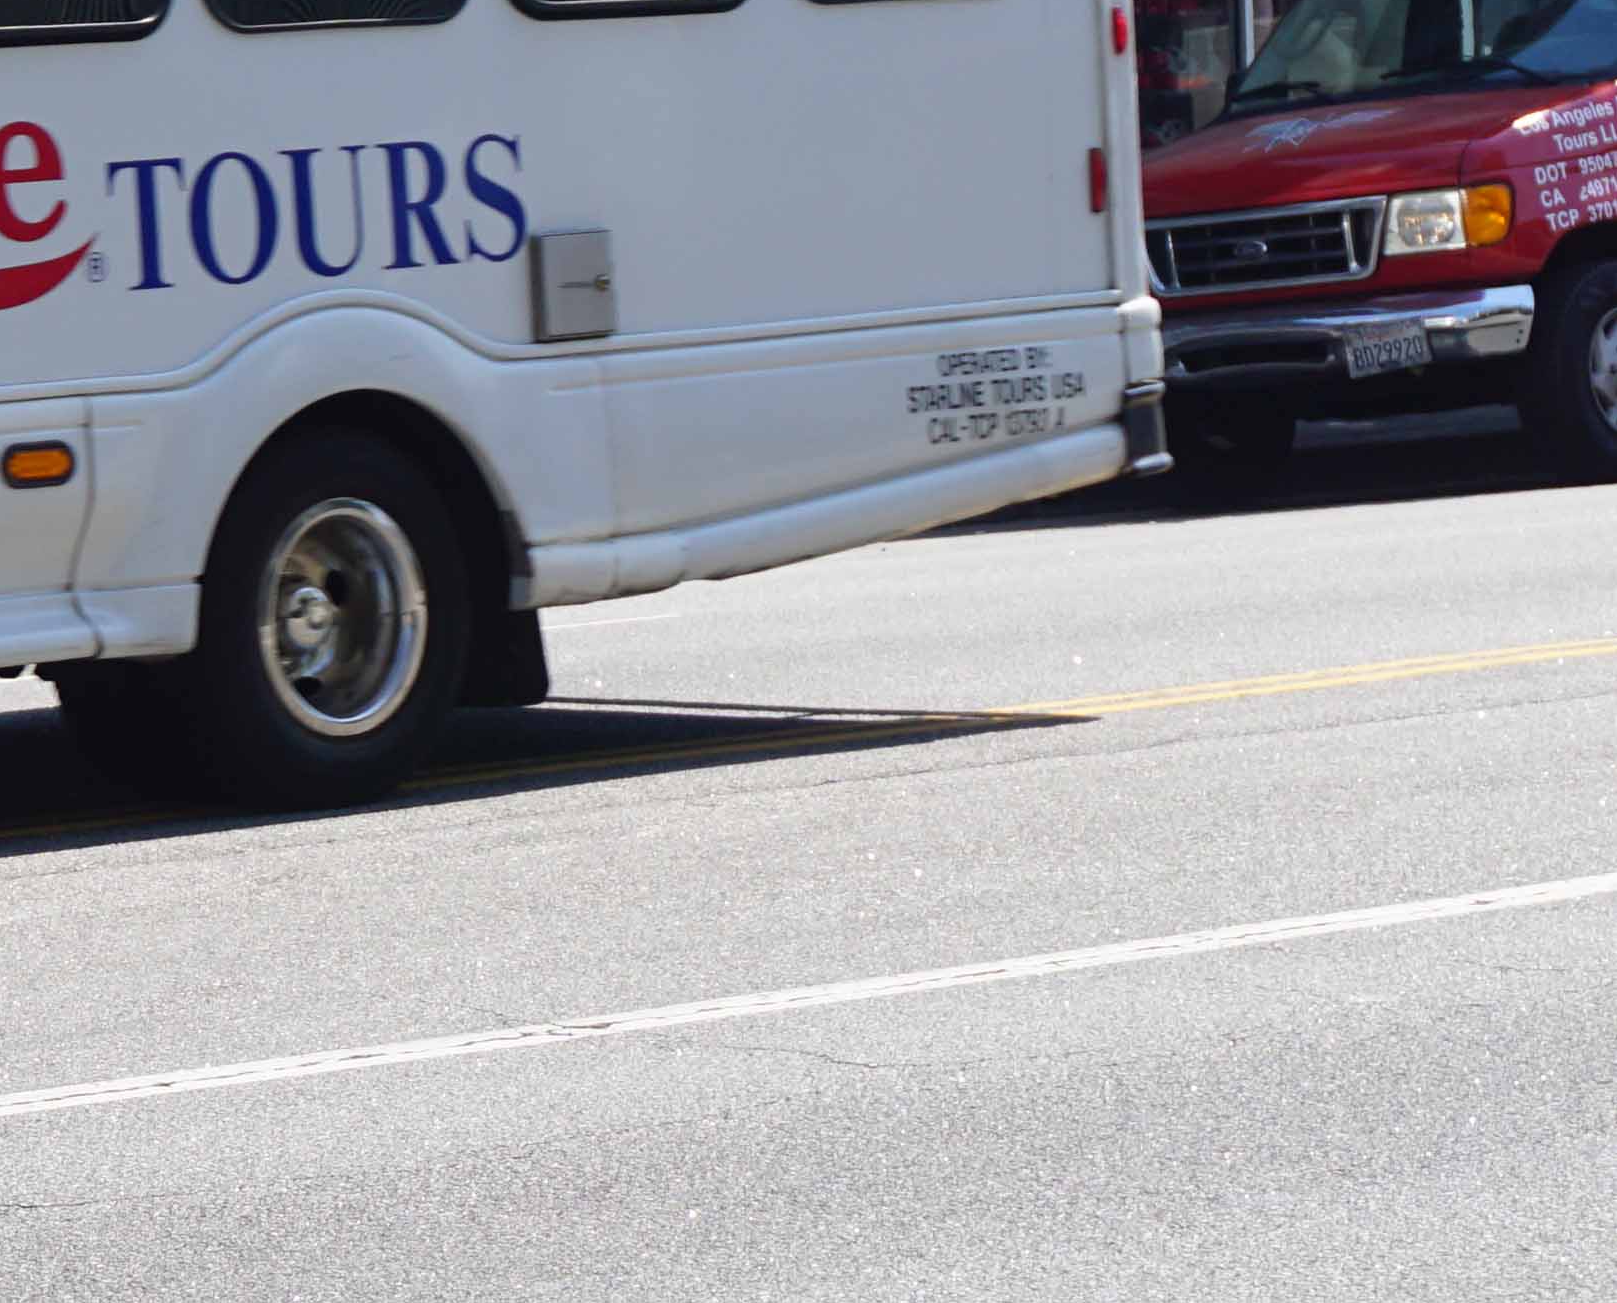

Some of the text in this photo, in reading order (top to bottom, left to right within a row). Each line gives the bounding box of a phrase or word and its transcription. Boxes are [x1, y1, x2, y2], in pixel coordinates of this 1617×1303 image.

[1551, 100, 1614, 128] Angeles
[1552, 130, 1598, 155] Tours
[1534, 161, 1568, 186] DOT
[1540, 188, 1566, 208] CA
[104, 133, 527, 292] TOURS
[1545, 208, 1579, 233] TCP
[936, 348, 1021, 378] OPERATED
[907, 371, 1086, 414] STARLINE TOURS USA
